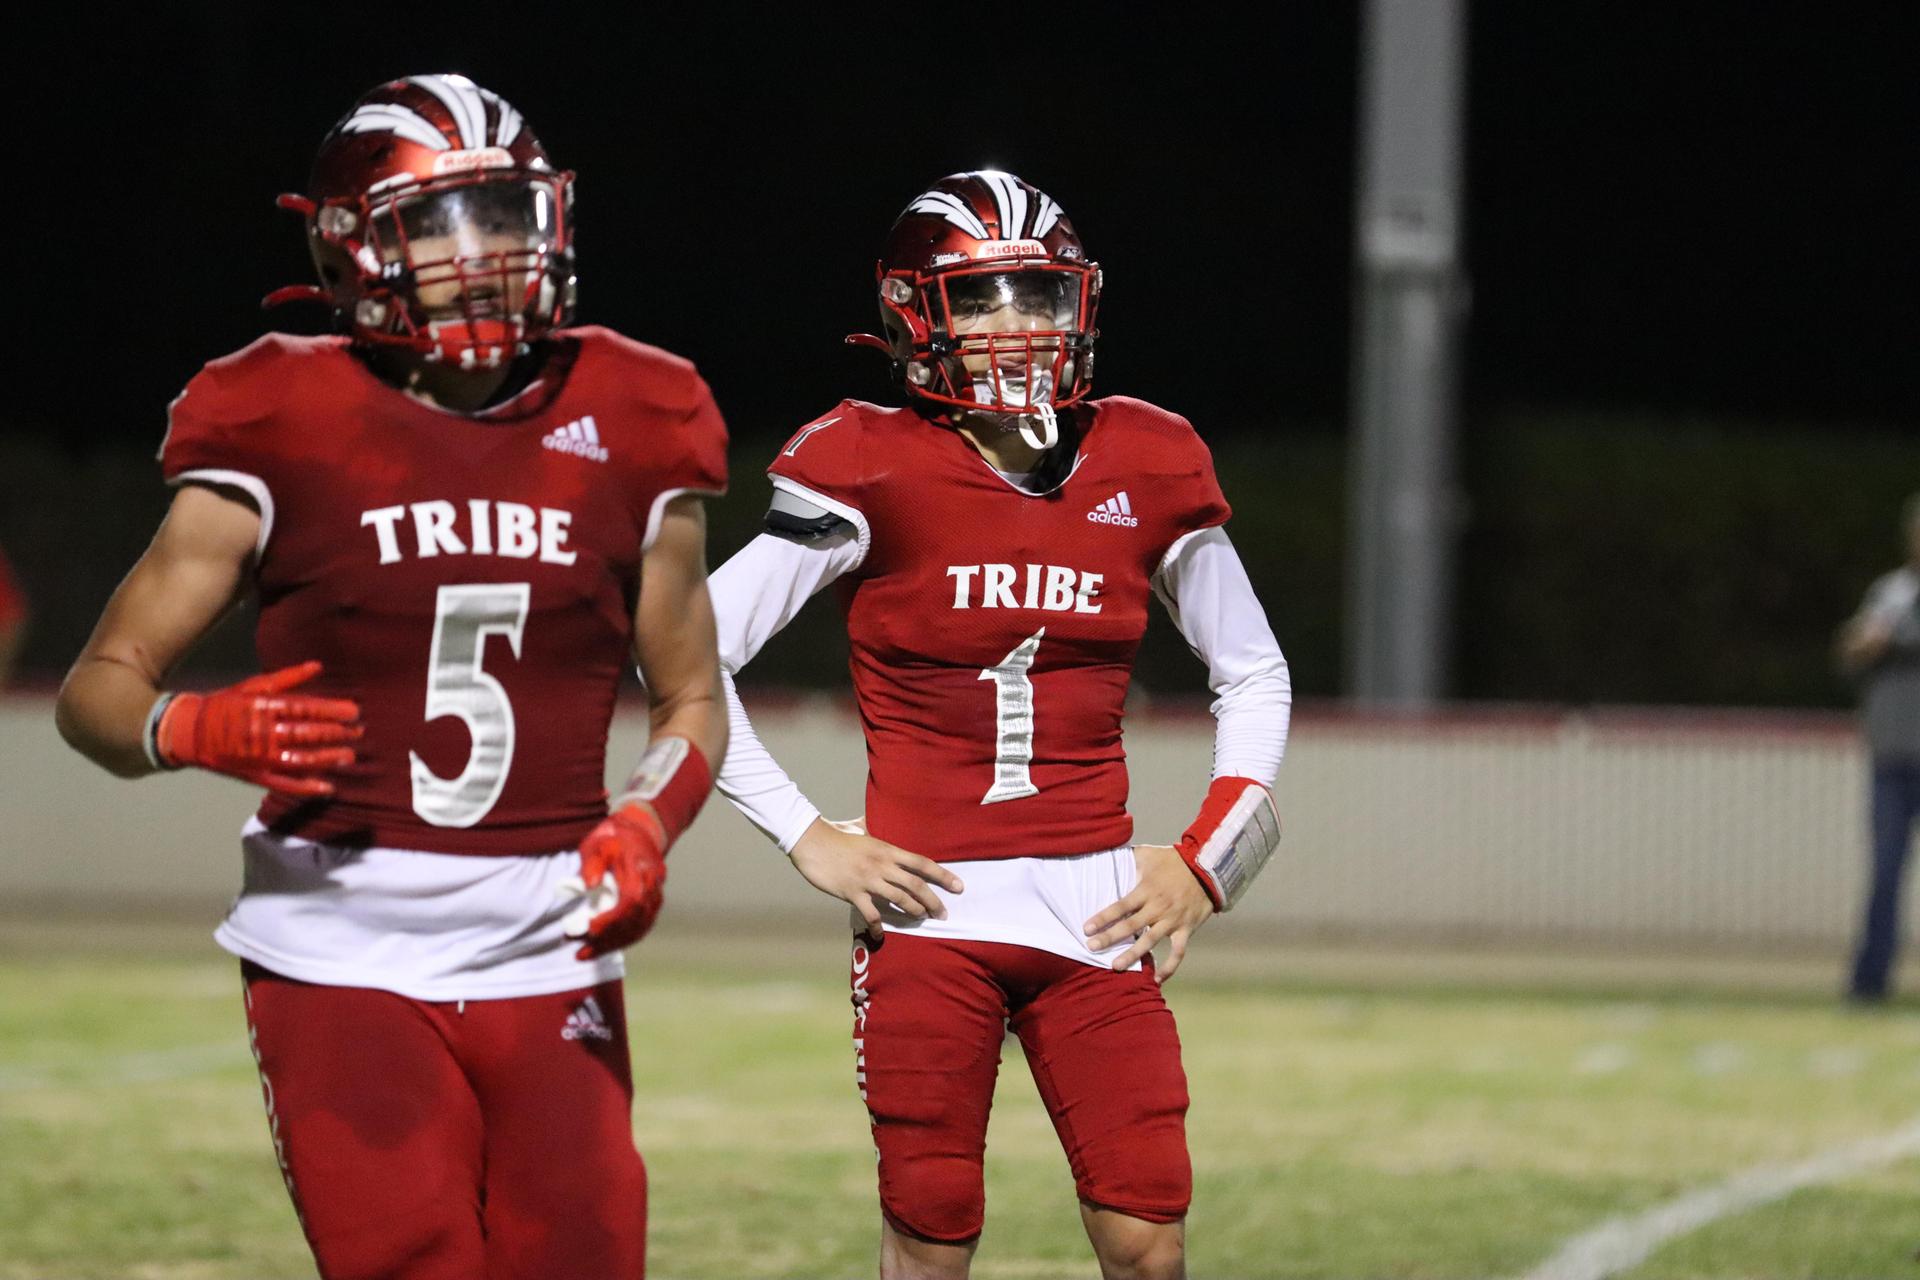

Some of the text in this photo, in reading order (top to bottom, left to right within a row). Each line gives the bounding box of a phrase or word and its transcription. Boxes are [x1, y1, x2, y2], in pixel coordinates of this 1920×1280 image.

[541, 433, 609, 464] adidas
[360, 499, 577, 566] TRIBE
[1087, 510, 1138, 527] adidas
[946, 563, 1104, 614] TRIBE
[409, 583, 531, 829] 5
[977, 626, 1046, 805] 1
